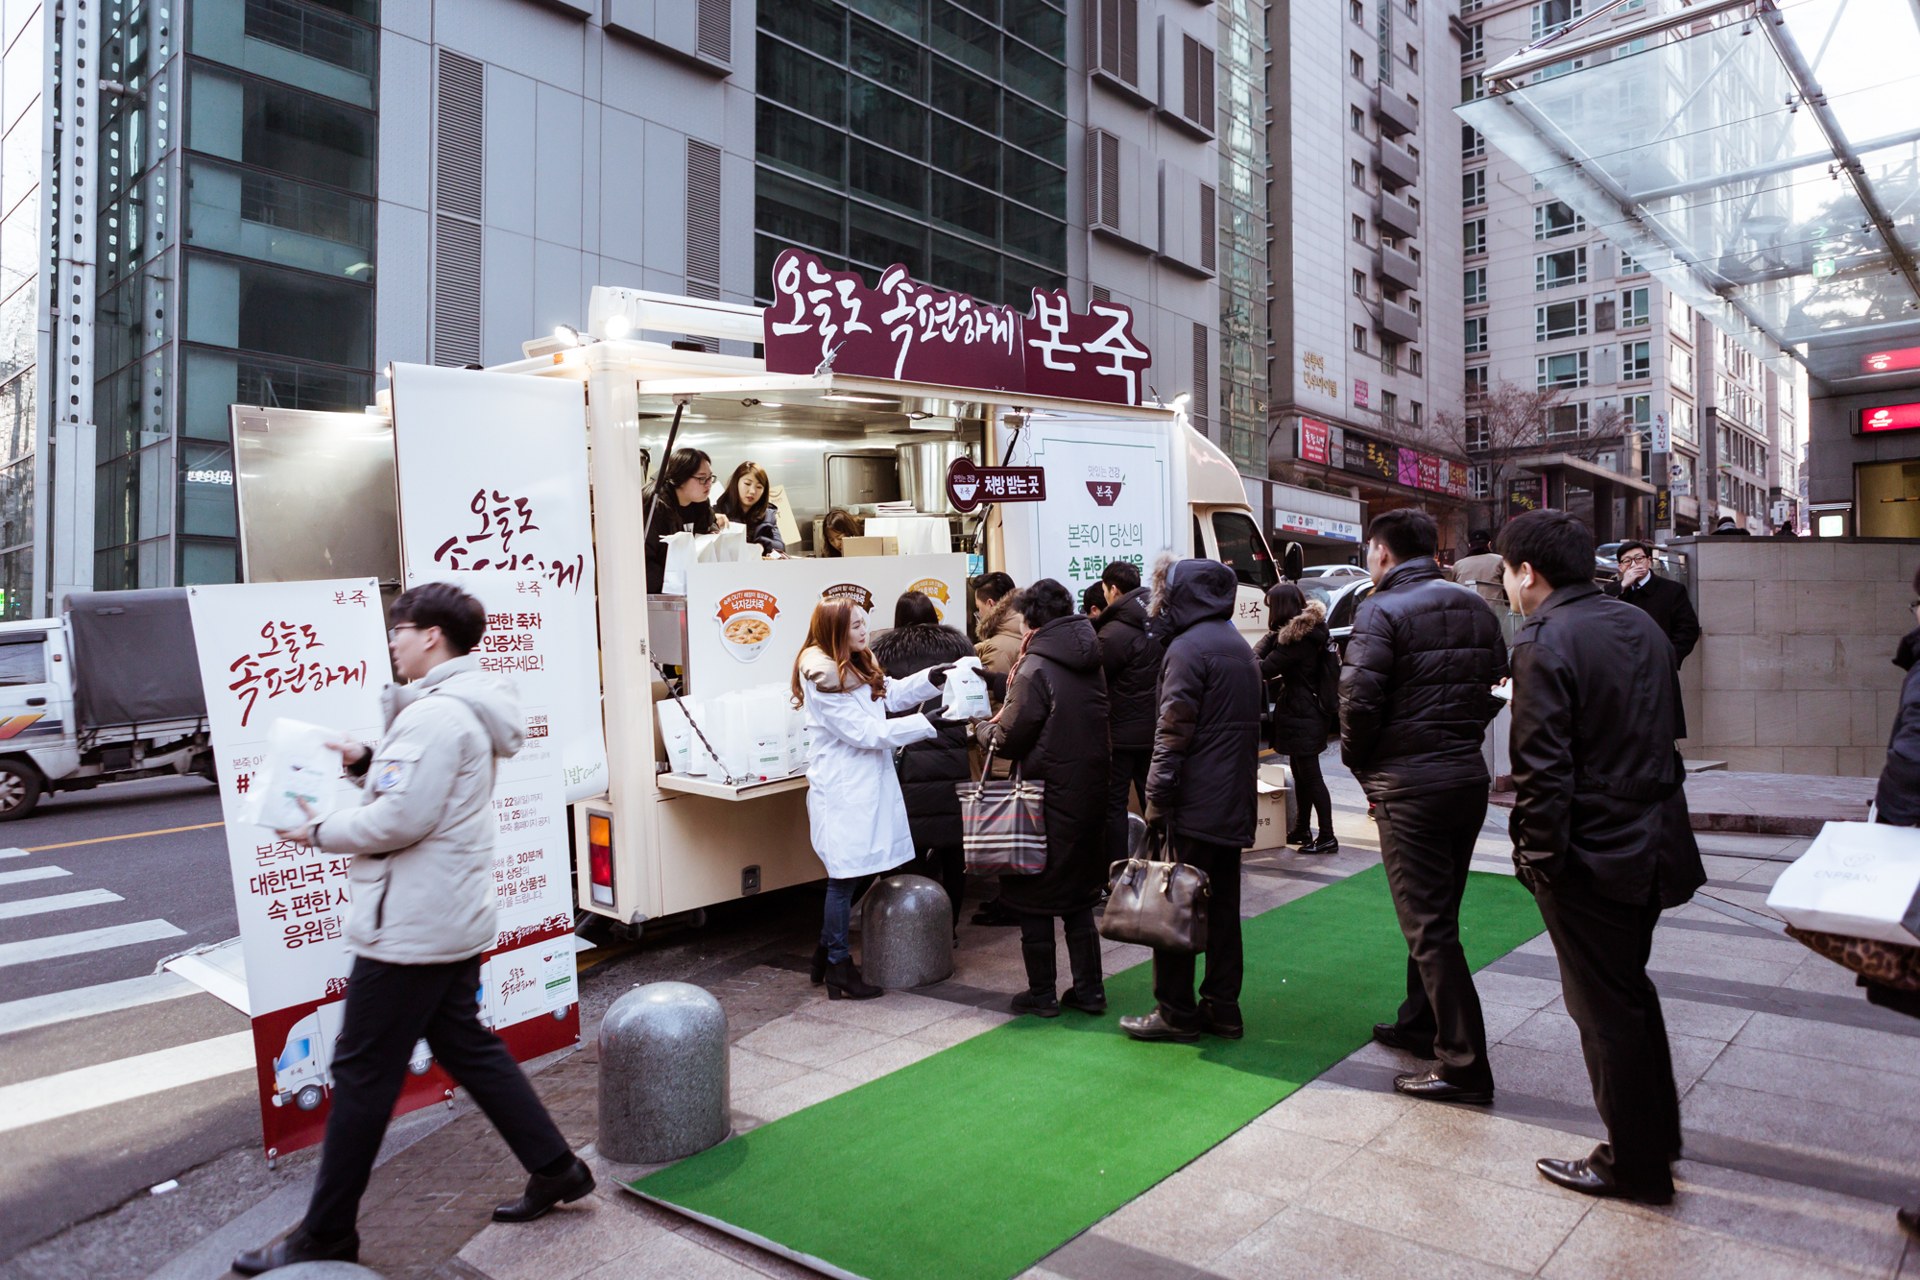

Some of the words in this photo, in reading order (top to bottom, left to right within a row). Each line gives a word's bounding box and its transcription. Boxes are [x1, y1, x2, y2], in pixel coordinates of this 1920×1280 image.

[772, 255, 872, 358] 오늘도
[1028, 294, 1149, 406] 본죽
[1088, 465, 1107, 478] 맛있는
[1108, 466, 1120, 478] 건강
[985, 475, 1005, 495] 처방
[1006, 475, 1027, 495] 받는
[1028, 475, 1039, 494] 곳
[1096, 485, 1113, 501] 본죽
[466, 488, 540, 553] 오늘도
[1068, 523, 1105, 548] 본죽이
[1109, 522, 1143, 548] 당신의
[1068, 556, 1081, 581] 속
[1083, 555, 1108, 580] 편한
[332, 590, 370, 607] 본죽
[516, 581, 542, 597] 본죽
[731, 599, 764, 610] 낙지김치죽
[1239, 601, 1262, 625] 본죽
[487, 613, 514, 630] 편한
[516, 612, 542, 630] 죽차
[257, 620, 324, 663] 오늘도
[483, 633, 534, 653] 인증샷을
[228, 654, 367, 727] 속편하게
[233, 756, 251, 770] 본죽
[250, 862, 326, 896] 대한민국
[492, 870, 503, 882] 원
[497, 882, 517, 897] 바일
[519, 874, 547, 892] 상품권
[1813, 870, 1879, 884] ENPRANI
[267, 899, 288, 921] 속
[291, 889, 332, 918] 편한
[283, 914, 345, 949] 응원합
[542, 914, 570, 932] 본죽
